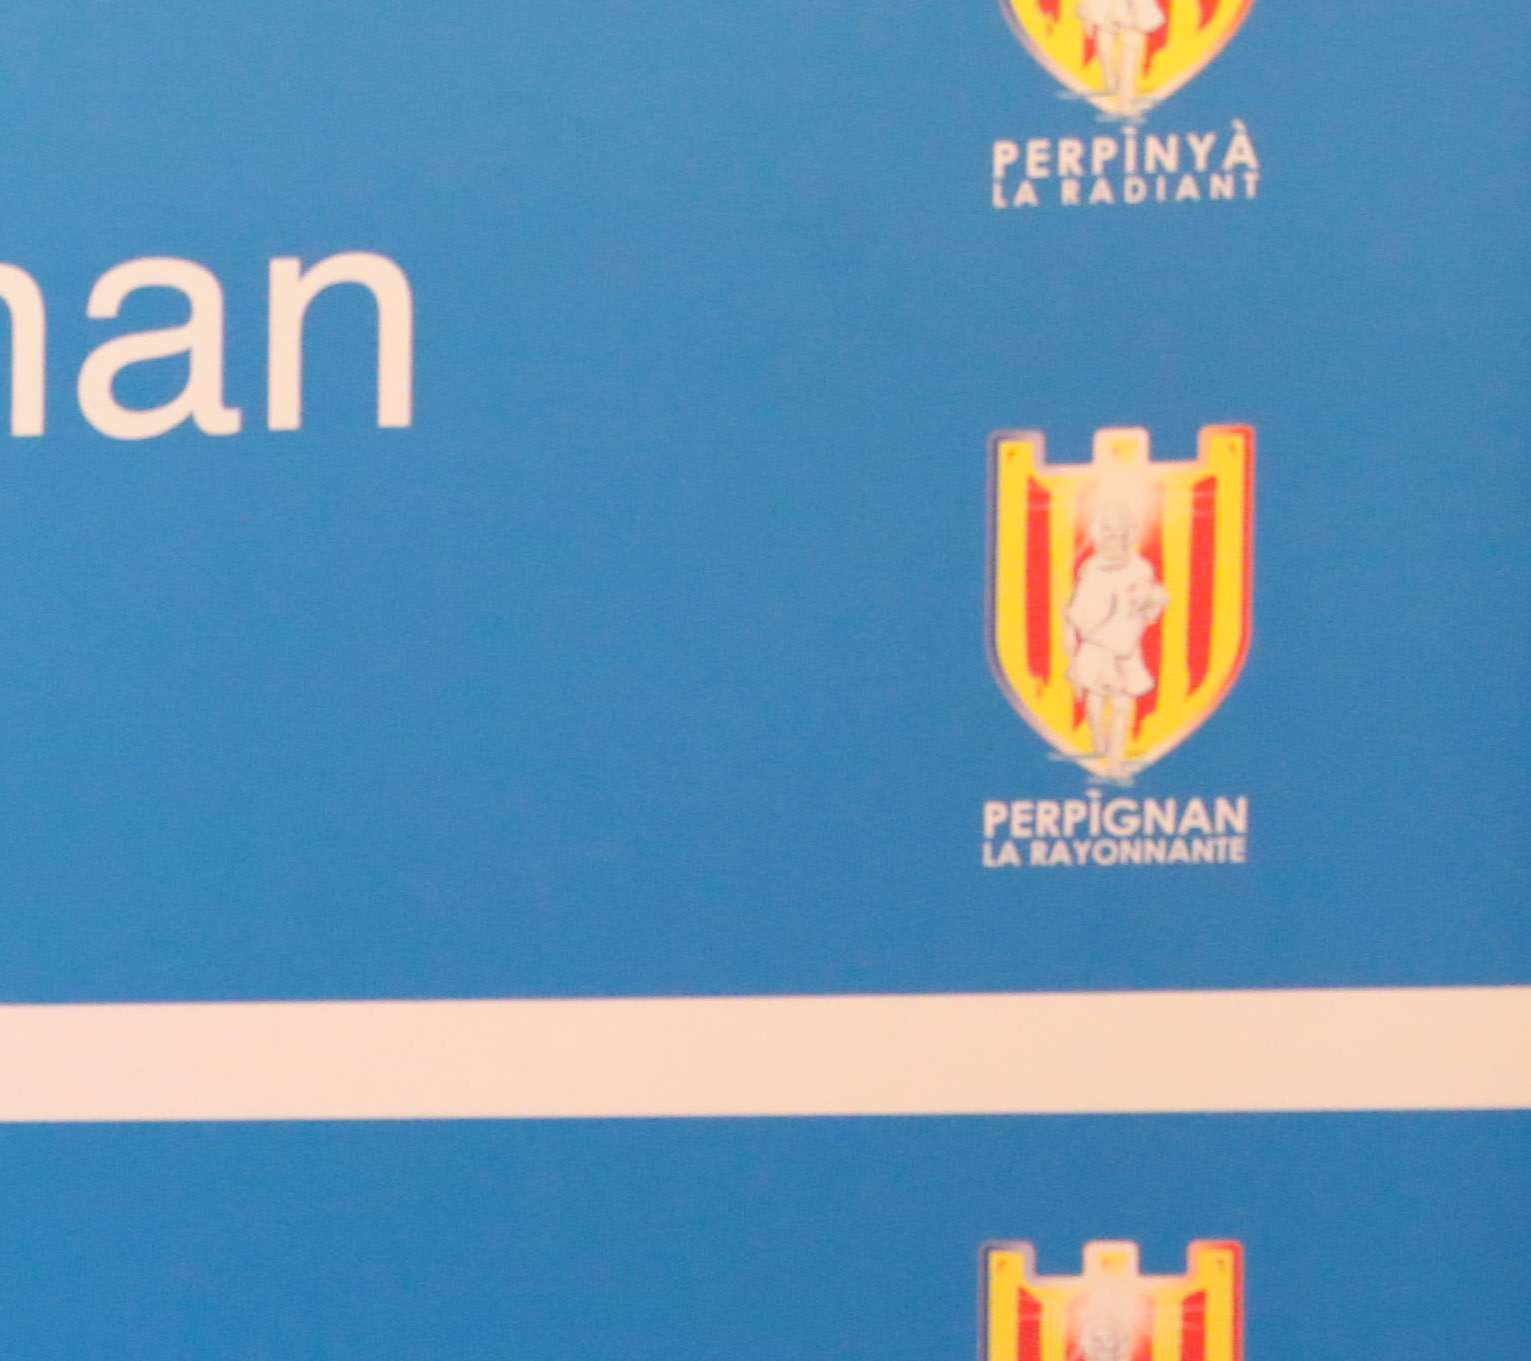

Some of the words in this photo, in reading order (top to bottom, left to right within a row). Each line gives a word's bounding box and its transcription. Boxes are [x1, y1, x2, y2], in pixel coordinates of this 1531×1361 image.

[992, 179, 1039, 209] LA
[1060, 172, 1259, 206] RADIANT
[982, 839, 1021, 868] LA
[1029, 836, 1247, 866] RAYONNANTE
